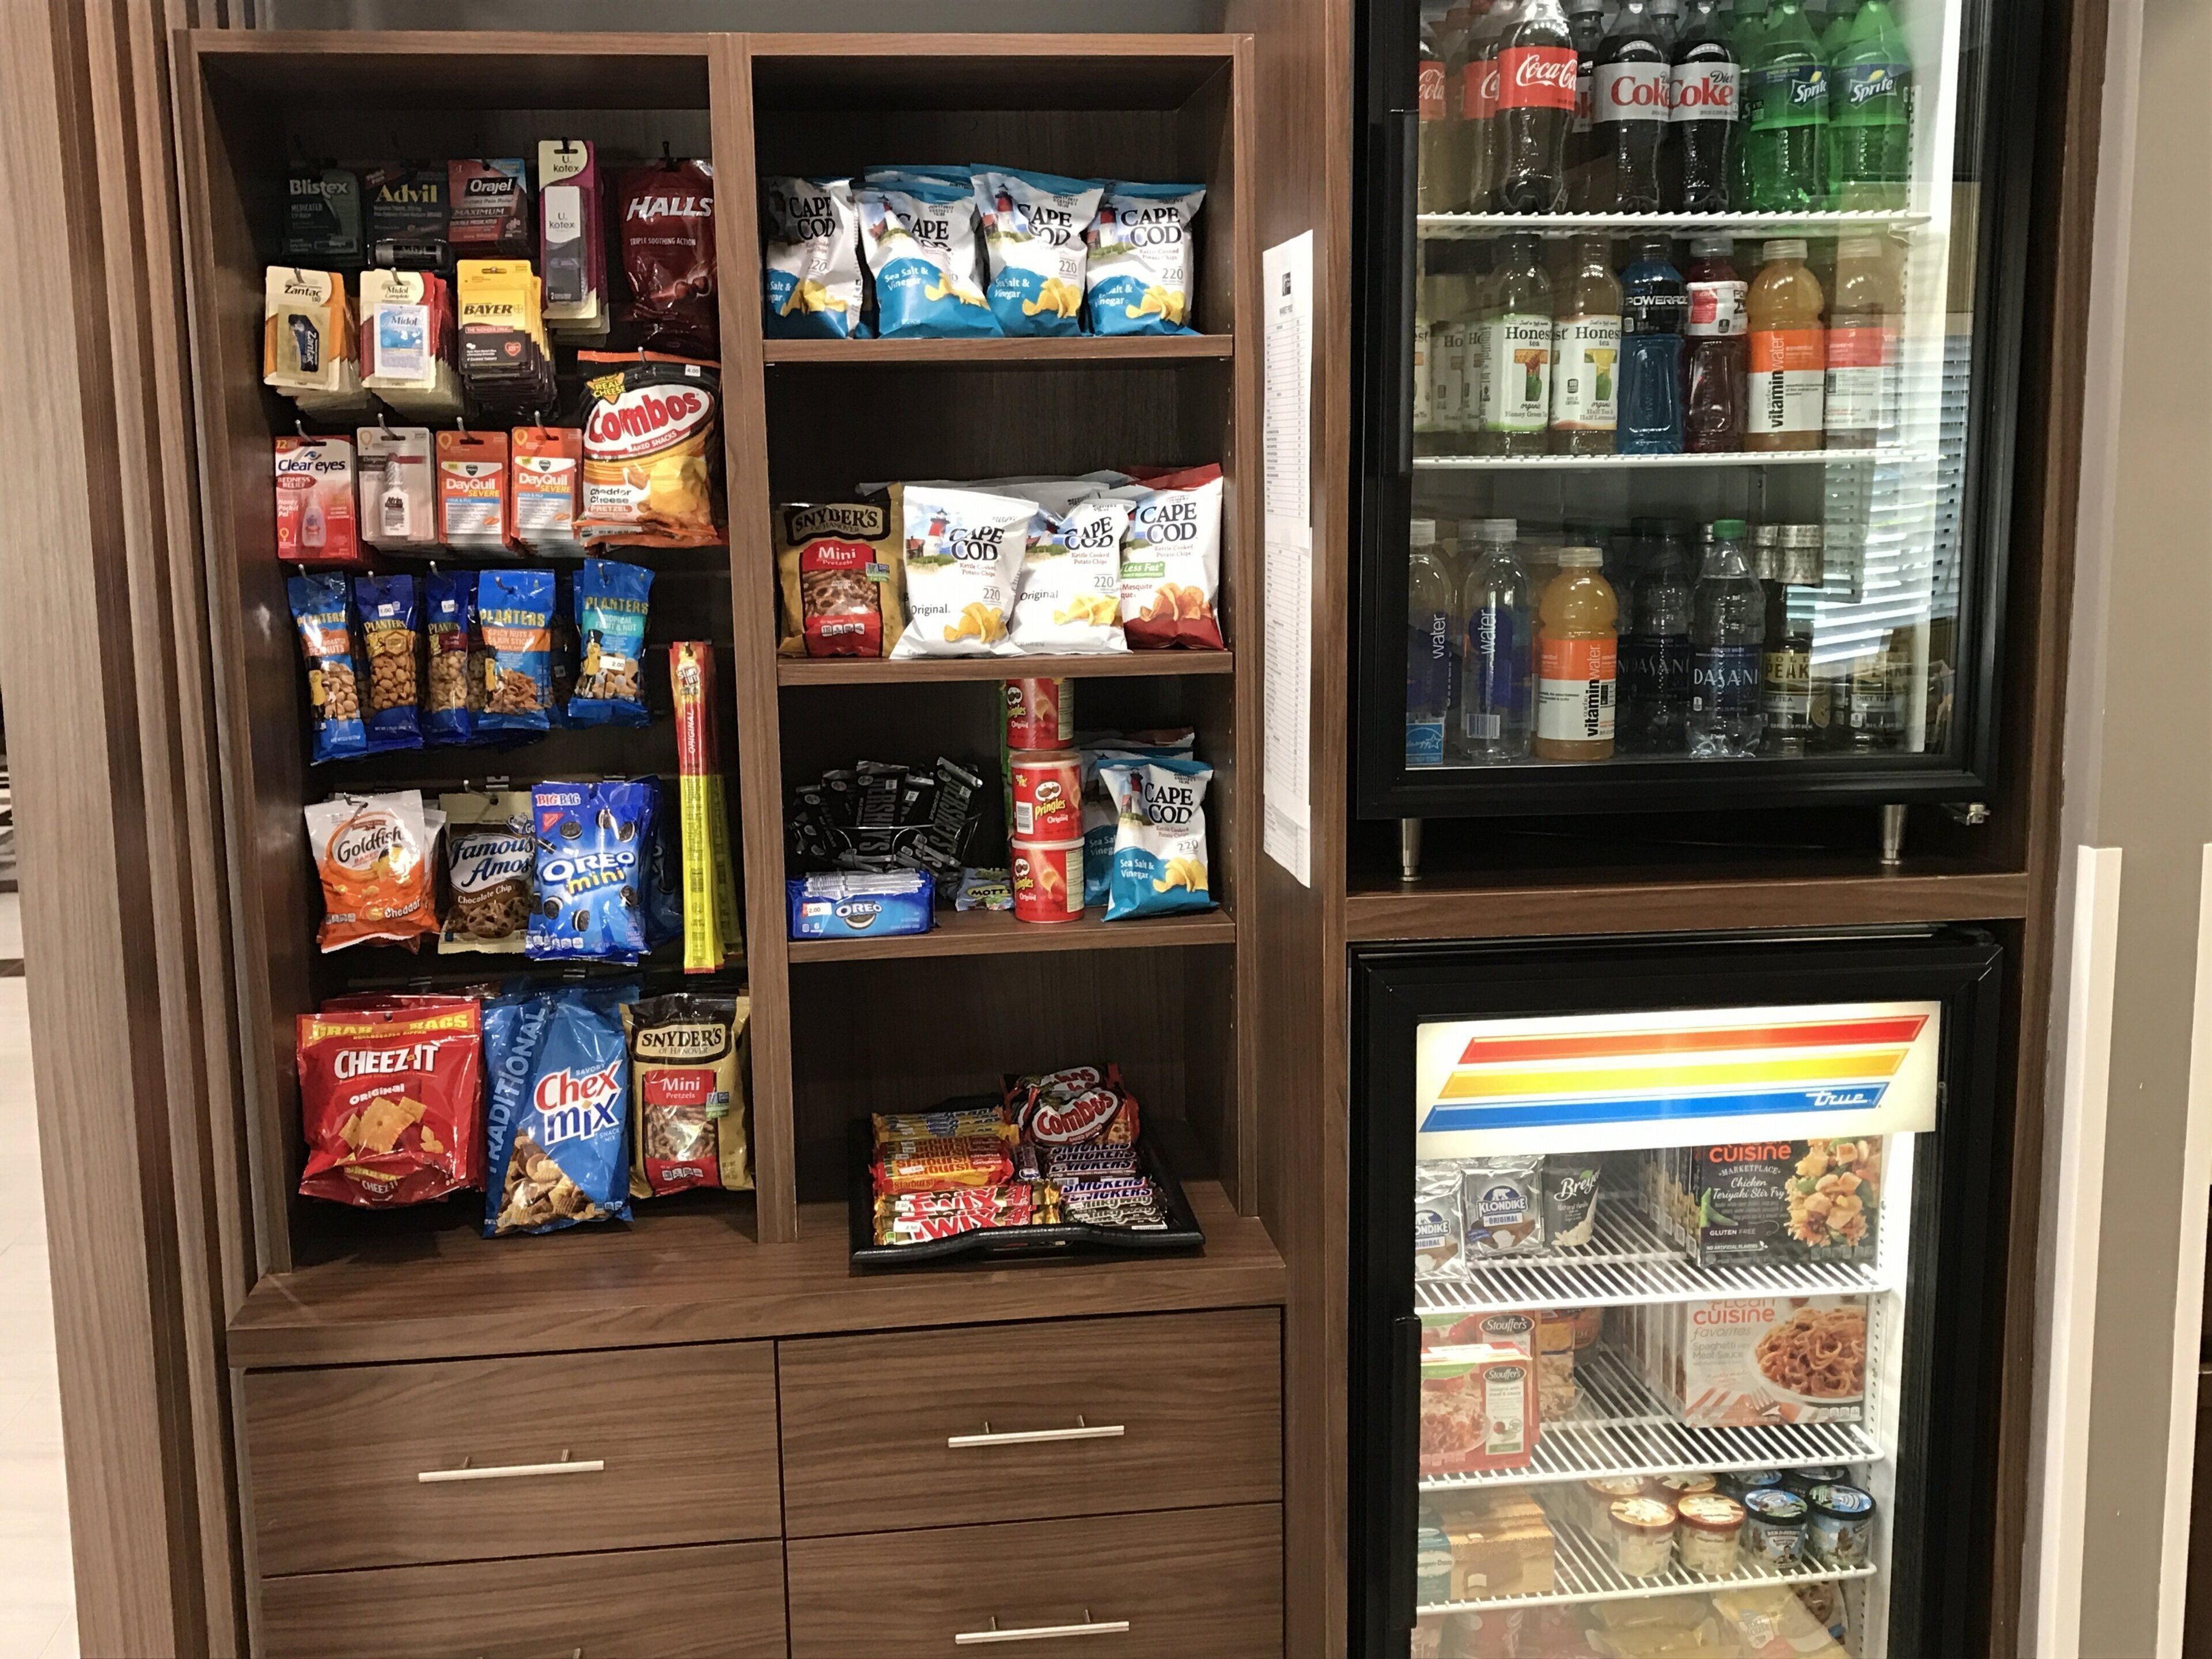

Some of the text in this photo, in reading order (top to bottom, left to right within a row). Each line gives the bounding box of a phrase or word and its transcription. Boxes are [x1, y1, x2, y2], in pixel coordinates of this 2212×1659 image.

[1710, 70, 1734, 84] Diet
[1666, 77, 1733, 109] Coke
[1794, 79, 1827, 103] Sprite
[1850, 77, 1893, 103] Sprite
[553, 163, 579, 173] kotex
[290, 179, 348, 198] Blistex
[376, 184, 437, 203] Advil
[470, 179, 513, 194] Orajel
[627, 196, 713, 222] HALLS
[789, 196, 833, 218] CAPE
[1018, 204, 1072, 228] CAPE
[1121, 207, 1181, 227] CAPE
[549, 220, 575, 229] kotex
[797, 218, 835, 243] COD
[630, 237, 696, 246] TRIPLE SOOTHING ACTION
[1028, 222, 1070, 246] COD
[1130, 226, 1182, 247] COD
[901, 266, 919, 278] Salt
[1059, 260, 1077, 274] 220
[1162, 268, 1183, 280] 220
[284, 285, 321, 297] Zantac
[887, 277, 922, 291] Vinegar
[1021, 279, 1030, 287] &
[1124, 285, 1132, 293] &
[994, 289, 1020, 299] Vinegar
[464, 304, 513, 315] BAYER
[391, 316, 417, 325] Midol
[306, 330, 317, 365] Zantac
[593, 386, 627, 398] CHEESE
[595, 381, 620, 391] REAL
[589, 392, 702, 443] Combos
[652, 431, 678, 448] SNACKS
[278, 460, 346, 474] Clear eyes
[446, 478, 495, 493] DayQuil
[519, 473, 567, 488] DayQuil
[468, 489, 500, 497] SEVERE
[795, 509, 878, 533] SNYDER'S
[1140, 502, 1197, 525] CAPE
[1064, 516, 1113, 538] CAPE
[1146, 522, 1197, 544] COD
[949, 526, 1005, 545] CAPE
[1064, 533, 1113, 551] COD
[818, 546, 856, 561] Mini
[950, 541, 998, 561] COD
[1124, 563, 1142, 573] Less
[1093, 576, 1114, 588] 220
[983, 588, 1001, 601] 220
[1020, 590, 1058, 601] Original
[584, 597, 649, 615] PLANTERS
[911, 604, 948, 617] Original
[480, 608, 545, 627] PLANTERS
[364, 620, 406, 633] PLANTERS
[1478, 609, 1495, 654] water
[1430, 615, 1445, 658] water
[1694, 668, 1758, 688] DASANI
[1766, 664, 1809, 679] PEAK
[536, 793, 581, 806] BIG BAG
[1145, 783, 1193, 806] CAPE
[1035, 798, 1066, 821] Pringles
[1148, 803, 1192, 824] COD
[338, 826, 402, 863] Goldfish
[453, 836, 535, 865] Famous
[1089, 838, 1103, 848] Sea
[1176, 839, 1199, 851] 220
[542, 851, 635, 882] OREO
[1120, 859, 1132, 869] Sea
[1134, 859, 1147, 869] Salt
[461, 858, 531, 888] Amos
[567, 866, 626, 895] mini
[1121, 869, 1149, 880] Vinegar
[457, 884, 512, 904] Chocolate Chip
[384, 897, 421, 919] Cheddar
[835, 902, 882, 918] OREO
[313, 1014, 468, 1040] GRAB BAGS
[642, 1028, 722, 1047] SNYDER'S
[670, 1047, 709, 1055] HANOVER
[334, 1044, 440, 1079] CHEEZ-IT
[576, 1063, 606, 1076] SAVORY
[488, 1007, 547, 1173] TRADITIONAL
[536, 1062, 620, 1111] Chex
[663, 1077, 700, 1092] Mini
[547, 1093, 619, 1142] mix
[1036, 1092, 1114, 1136] Combos
[599, 1128, 620, 1139] SNACK
[1722, 1164, 1779, 1177] MARKETPLACE
[1730, 1176, 1767, 1188] Chicken
[1712, 1187, 1785, 1204] Teriyaki Stir Fry
[1478, 1196, 1527, 1217] KLONDIKE
[896, 1212, 1001, 1240] TWIX
[1488, 1214, 1519, 1225] ORIGINAL
[1486, 1317, 1528, 1333] Stouffer's
[1692, 1327, 1751, 1342] favorites
[1693, 1342, 1736, 1352] Spaghetti
[1693, 1350, 1744, 1359] Meat Sauce
[1488, 1368, 1521, 1380] Stouffer's
